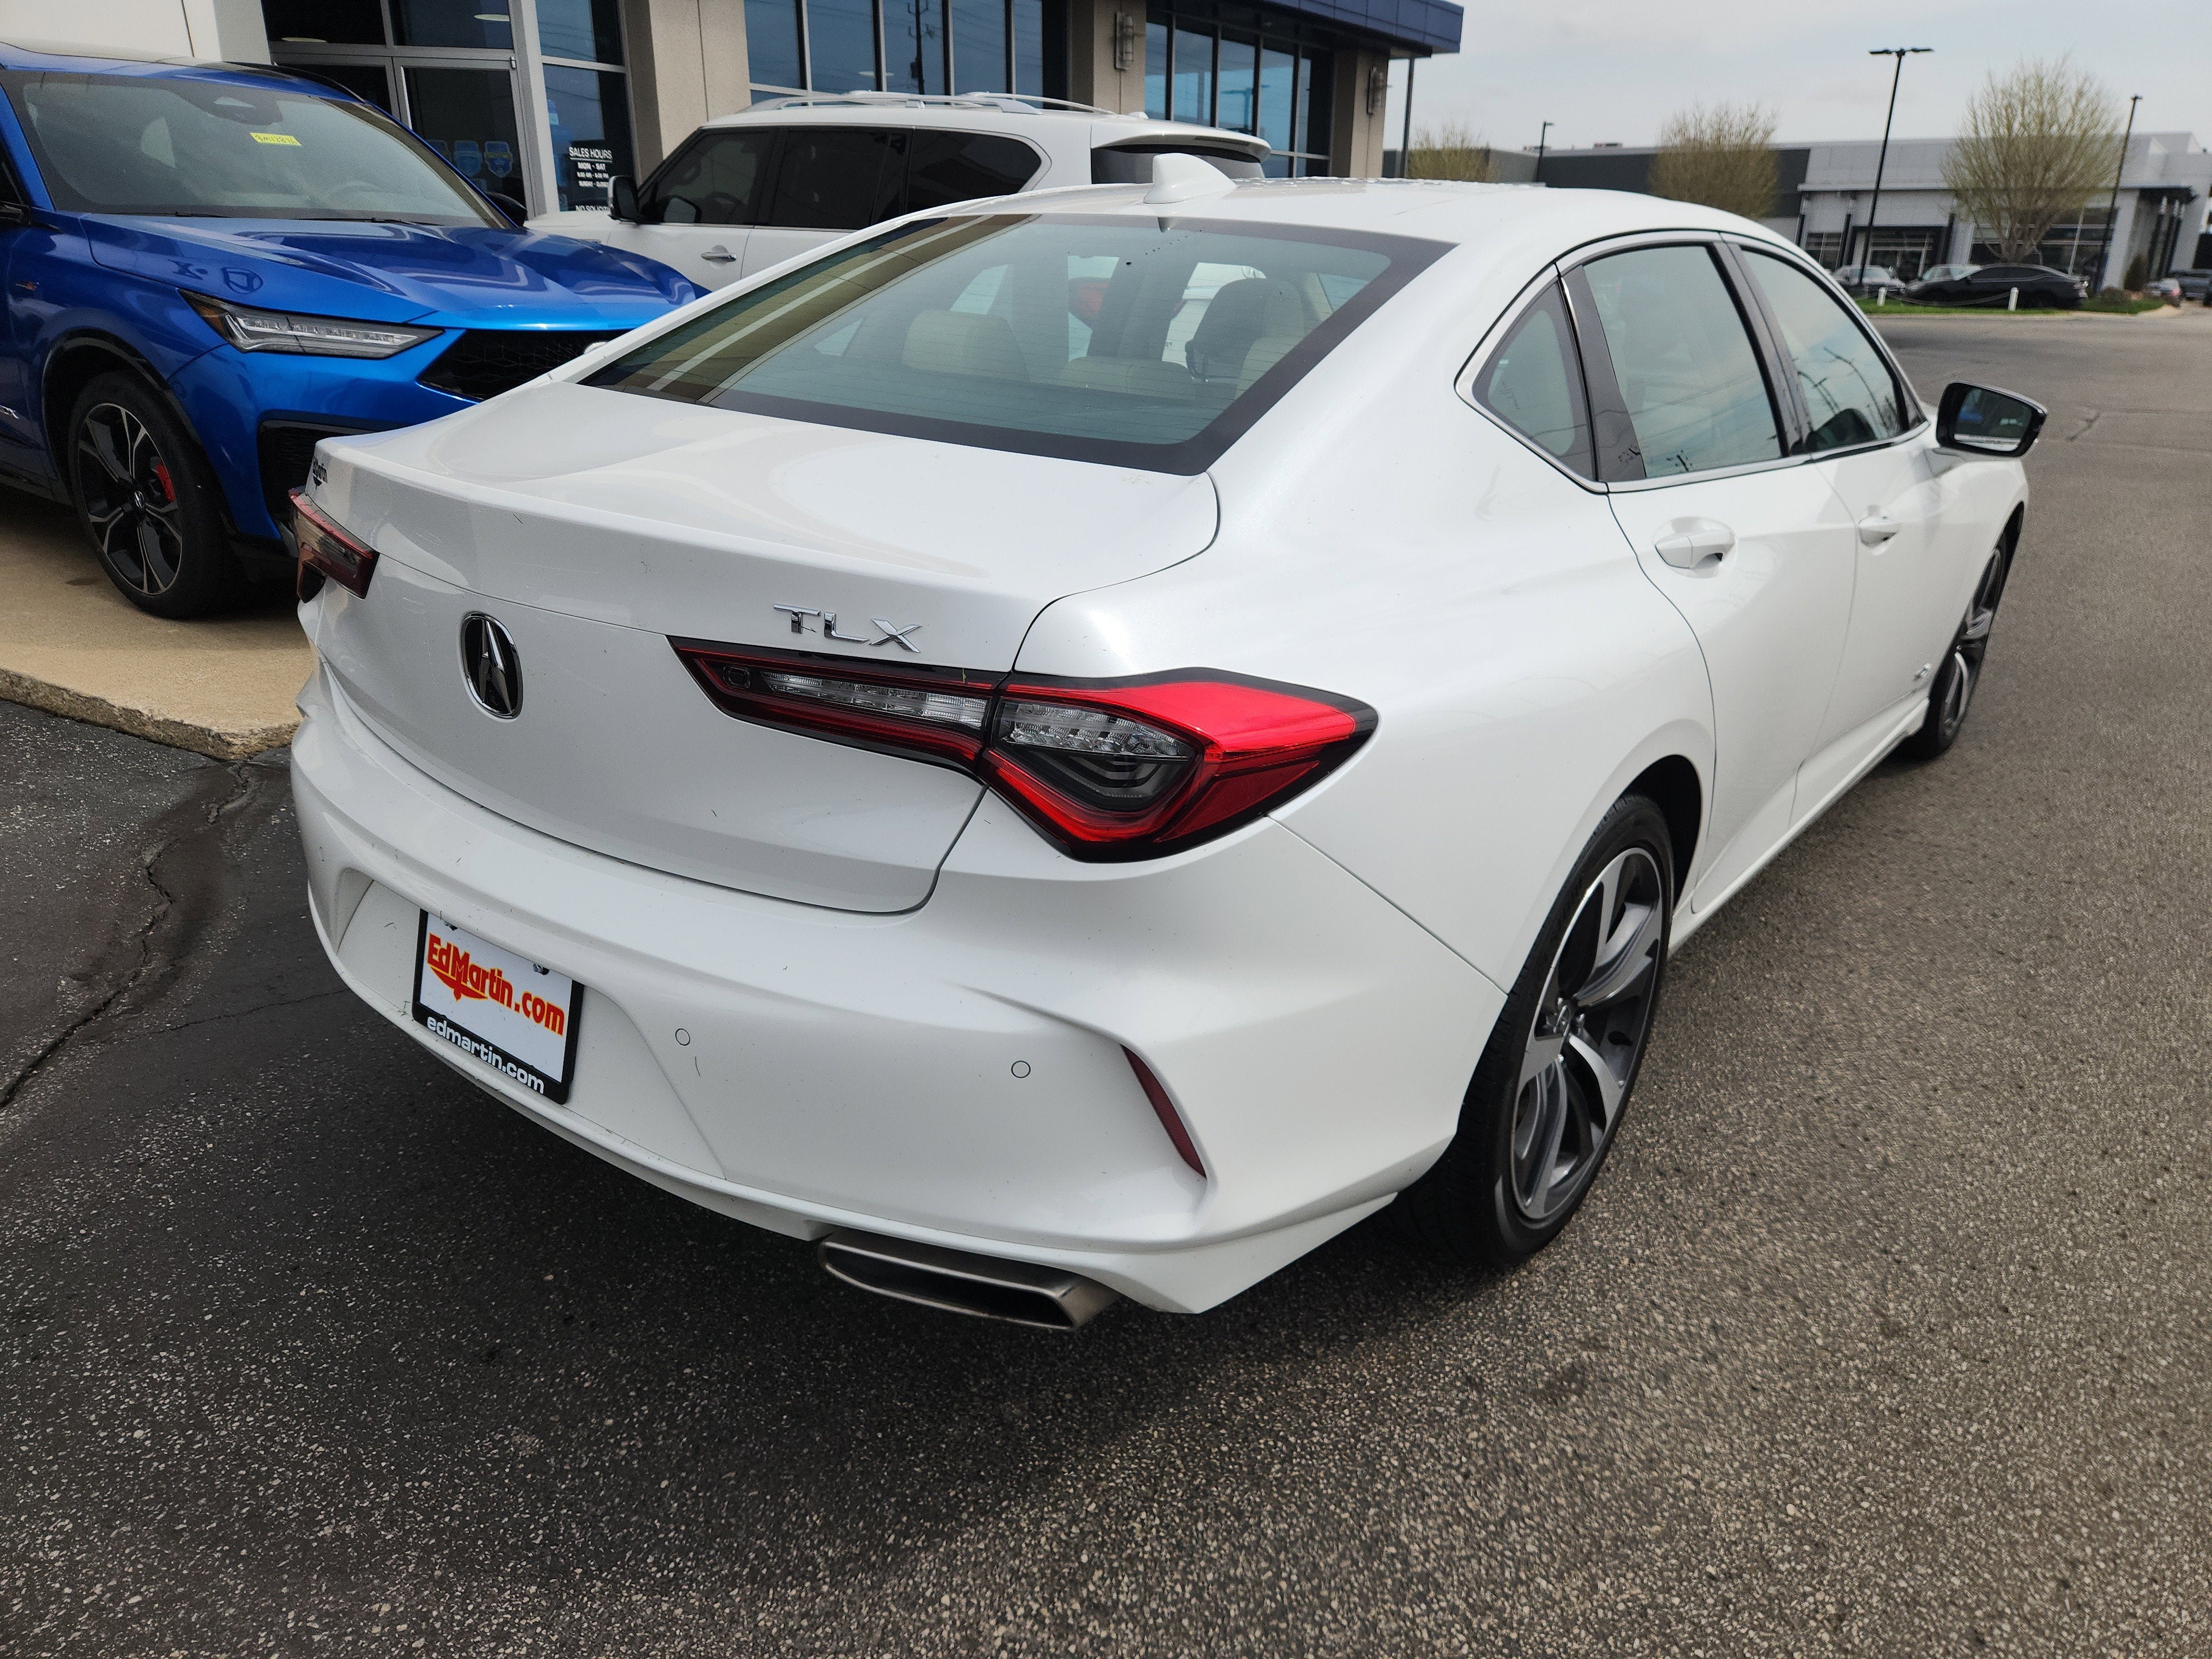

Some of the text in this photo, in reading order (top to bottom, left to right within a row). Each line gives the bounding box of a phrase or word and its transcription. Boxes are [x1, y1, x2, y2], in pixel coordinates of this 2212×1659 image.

[569, 147, 613, 160] SALES HOURS
[577, 162, 591, 171] MON
[595, 163, 606, 172] SAT
[773, 603, 922, 653] TLX
[427, 932, 565, 1037] EdMartin.com
[427, 1016, 544, 1094] edmartin.com
